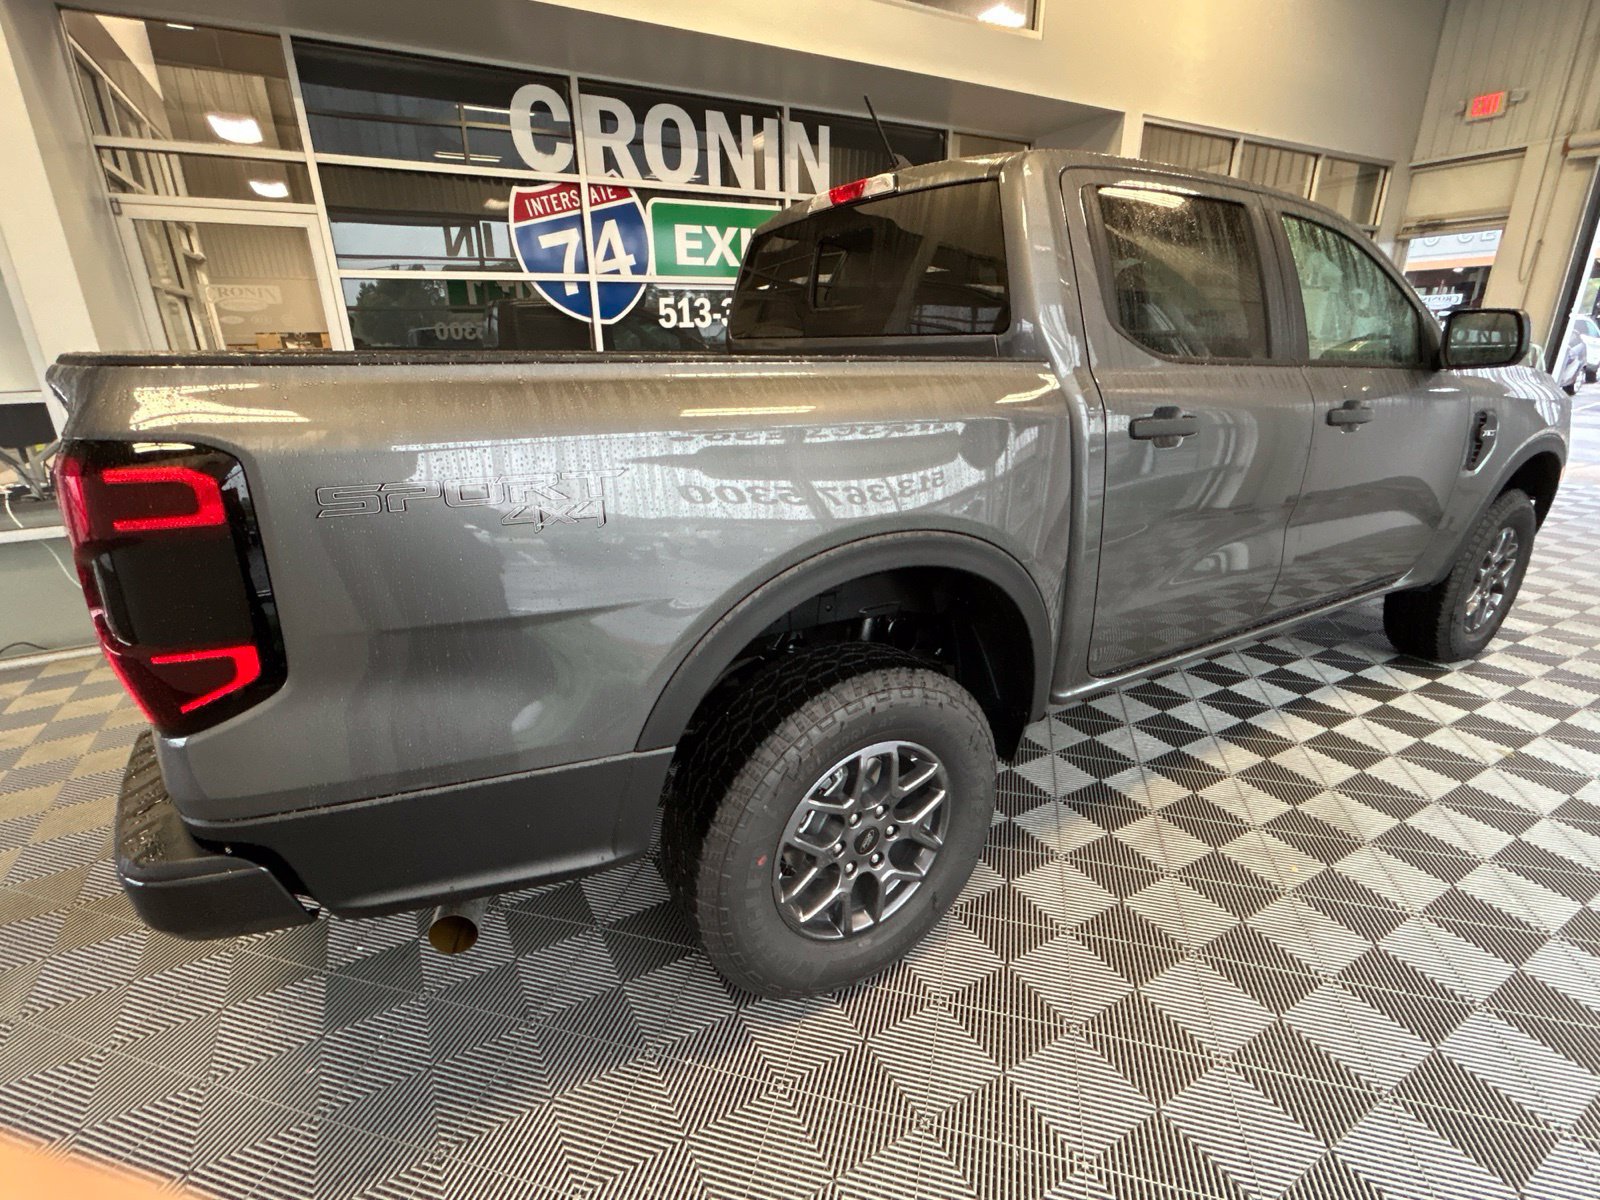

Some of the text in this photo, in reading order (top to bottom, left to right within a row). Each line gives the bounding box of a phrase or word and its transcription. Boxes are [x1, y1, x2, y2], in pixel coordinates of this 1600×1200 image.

[1472, 90, 1504, 117] EXIT
[509, 84, 831, 196] CRONIN
[525, 185, 617, 217] INTERSATE
[538, 219, 636, 296] 74
[674, 223, 757, 267] EXI
[316, 468, 627, 518] SPORT
